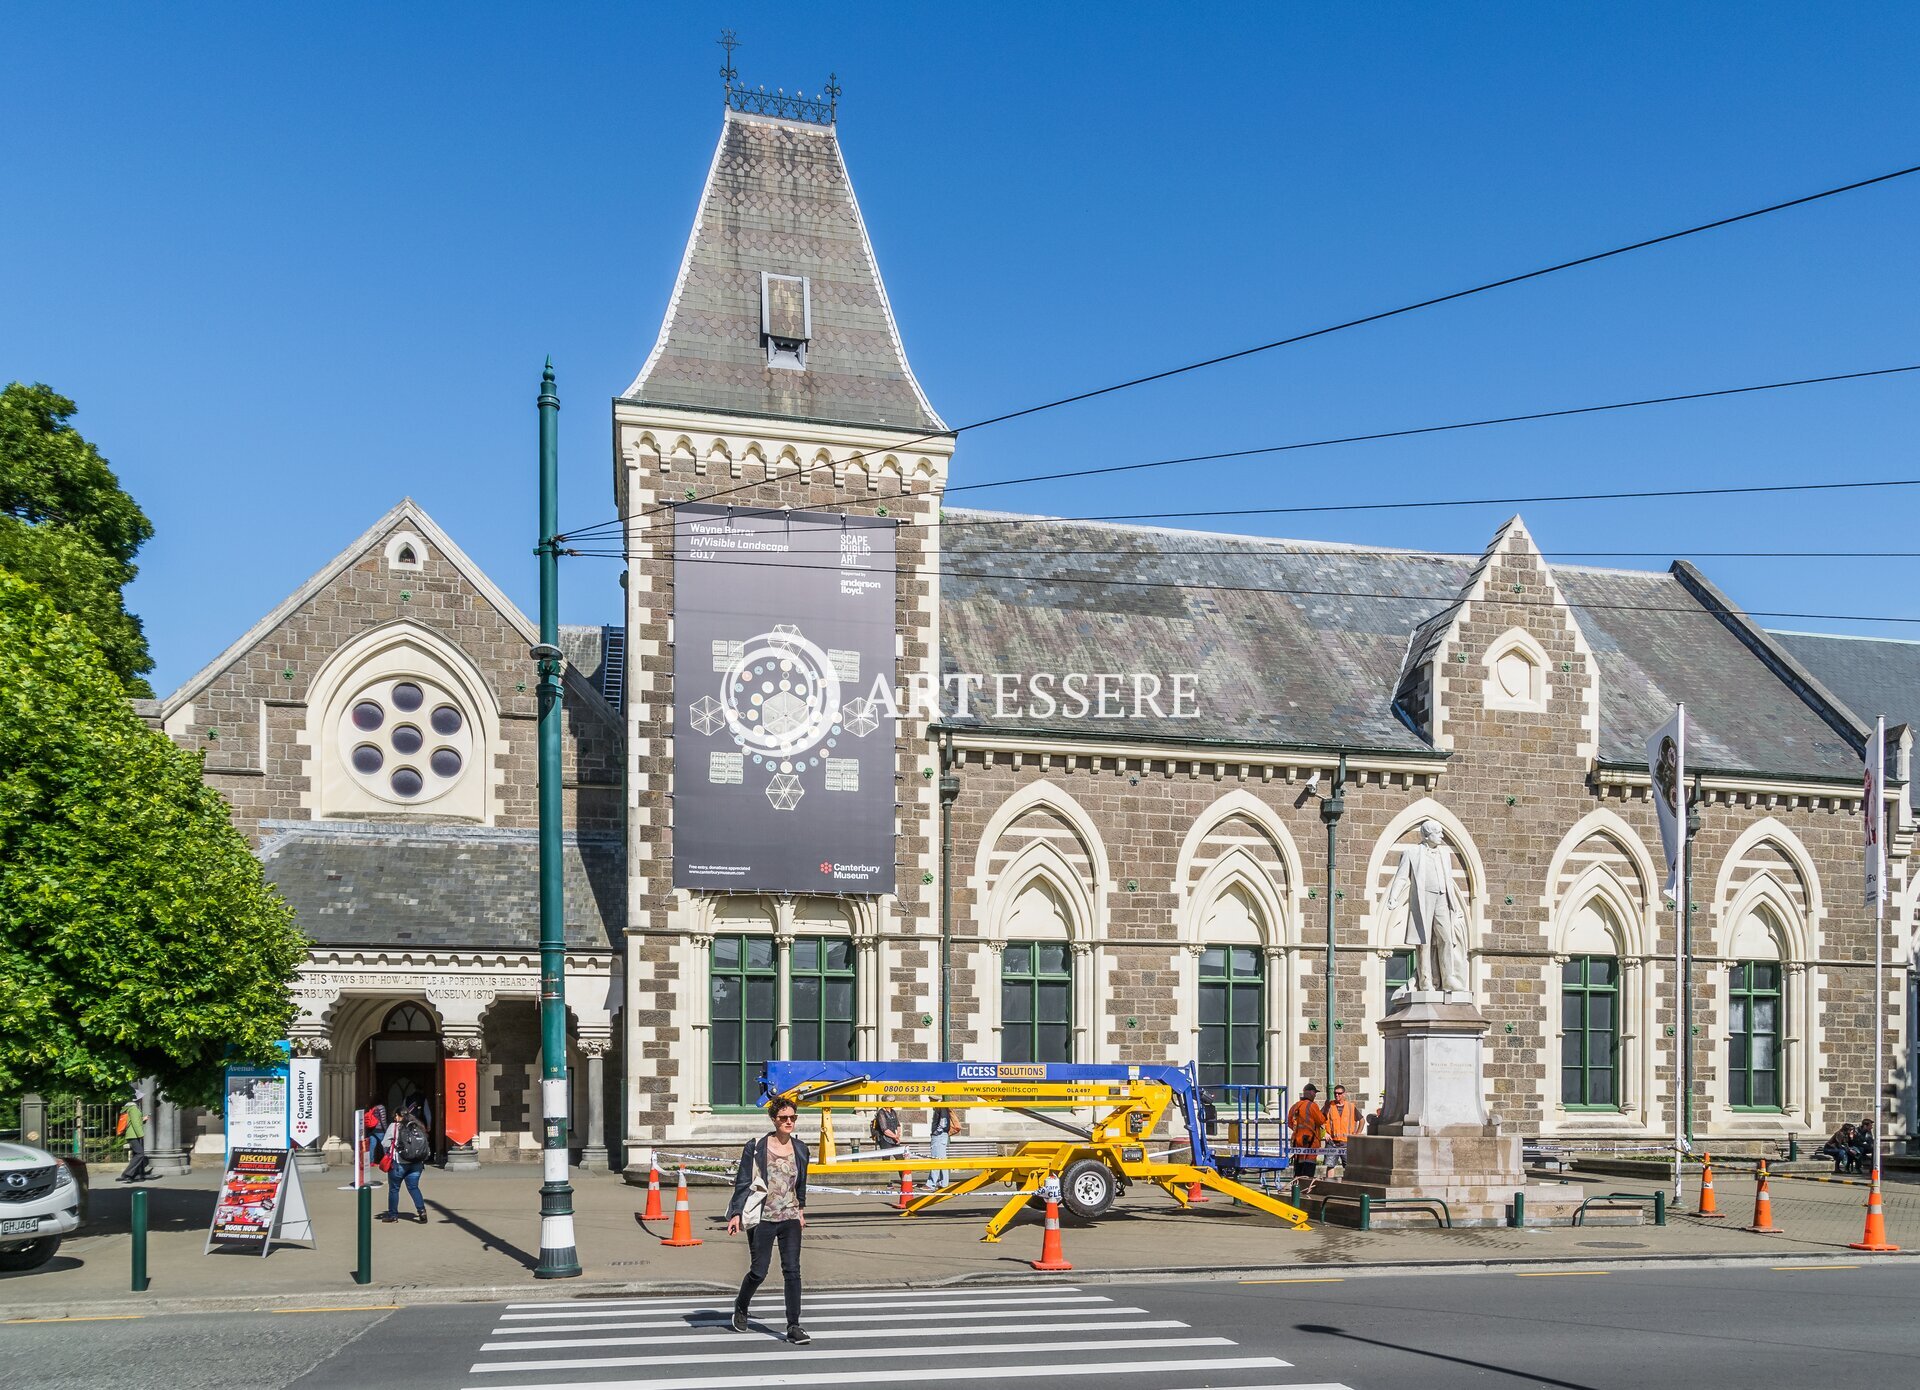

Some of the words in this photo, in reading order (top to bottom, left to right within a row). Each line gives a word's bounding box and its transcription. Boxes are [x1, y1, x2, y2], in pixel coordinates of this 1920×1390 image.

[690, 523, 722, 534] Wayne
[690, 536, 735, 548] In/Visible
[737, 540, 789, 553] Landscape
[841, 534, 868, 546] SCAPE
[690, 549, 715, 559] 2017
[841, 545, 871, 556] PUBLIC
[841, 554, 857, 565] ART
[841, 579, 881, 588] anderson
[834, 863, 880, 873] Canterbury
[834, 871, 869, 880] Museum
[309, 974, 327, 984] HIS
[331, 975, 355, 984] WAYS
[359, 975, 376, 984] BUT
[380, 976, 400, 984] HOW
[405, 976, 436, 985] LITTLE
[440, 977, 446, 985] A
[449, 976, 485, 986] PORTION
[489, 977, 496, 986] IS
[500, 978, 526, 986] HEARD
[428, 989, 471, 999] MUSEUM
[473, 989, 494, 999] 1870
[960, 1066, 996, 1077] ACCESS
[999, 1067, 1044, 1076] SOLUTIONS
[297, 1070, 306, 1119] Canterbury
[456, 1082, 466, 1113] open
[3, 1220, 37, 1232] GHJ464
